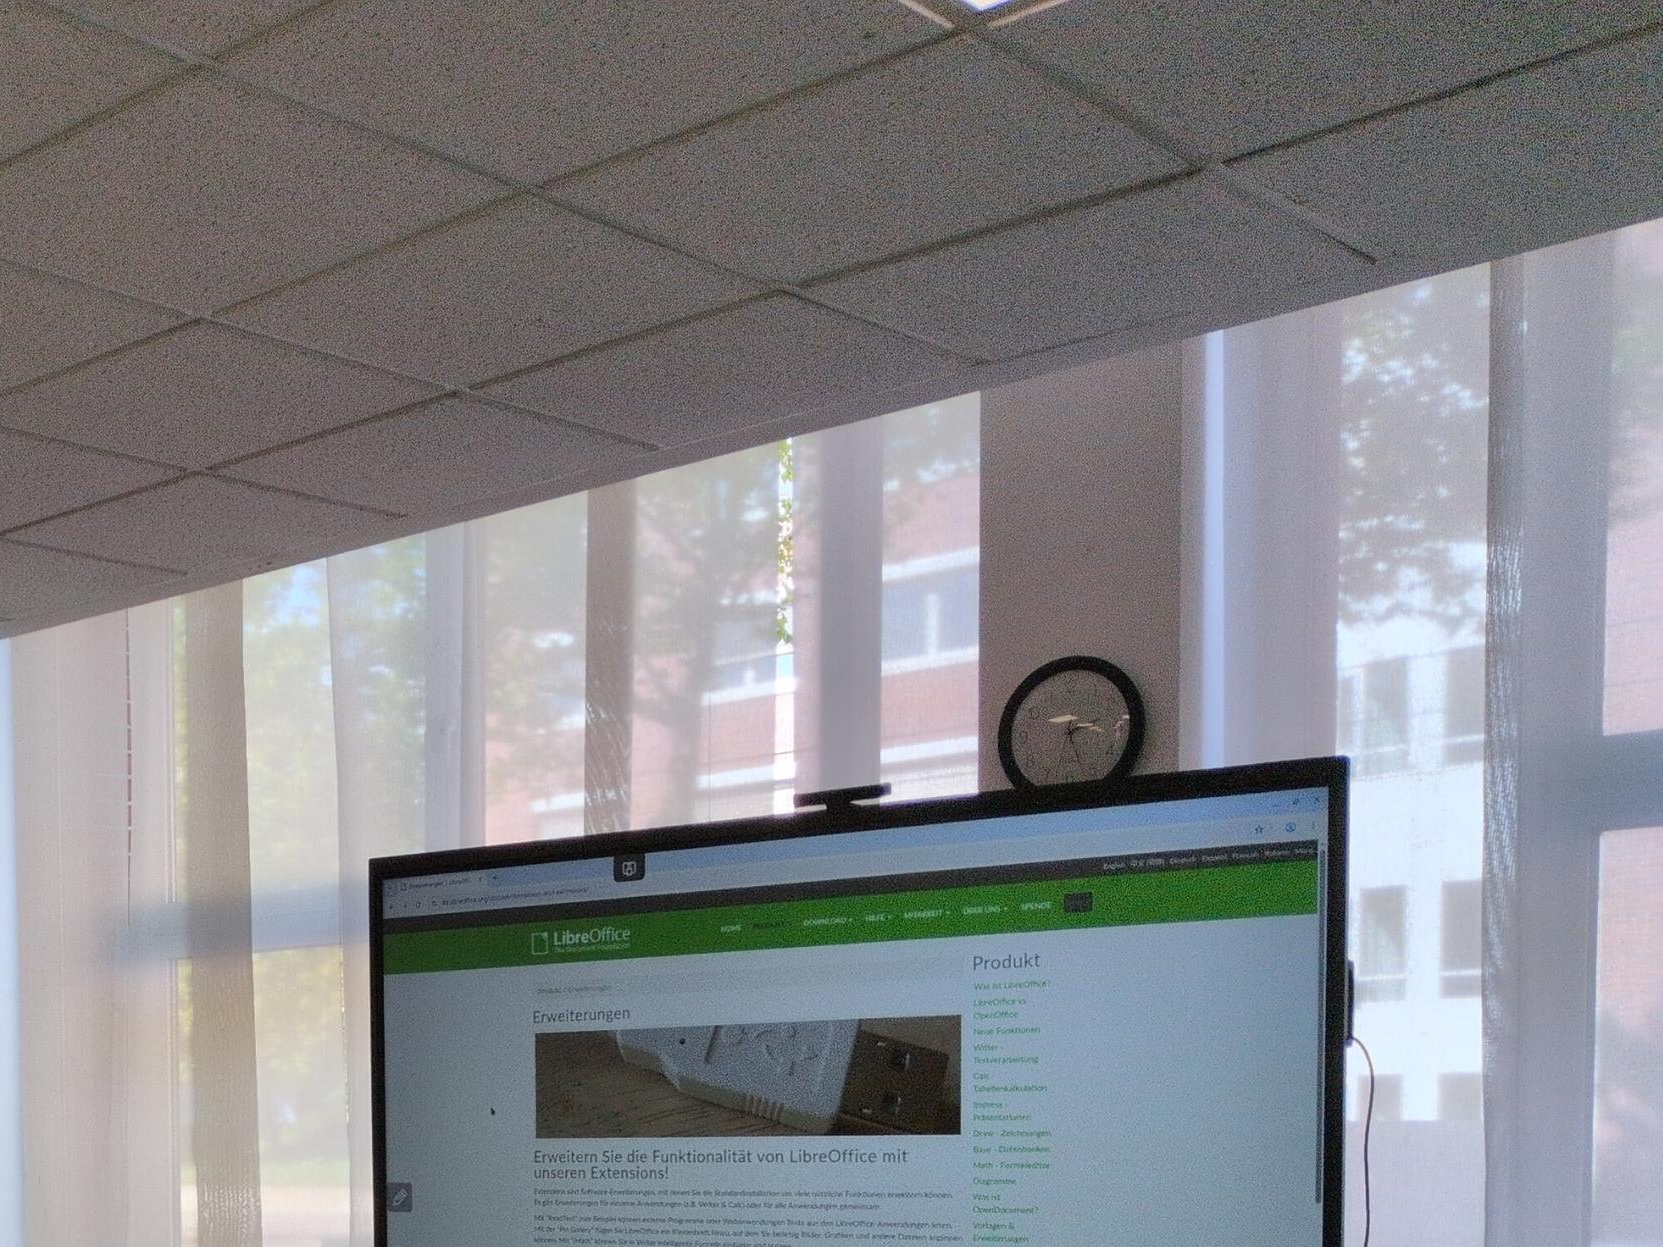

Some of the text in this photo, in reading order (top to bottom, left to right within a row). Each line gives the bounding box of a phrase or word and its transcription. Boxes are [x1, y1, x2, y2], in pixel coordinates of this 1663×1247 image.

[553, 926, 631, 946] LibreOffice
[972, 951, 1040, 970] Produkt
[533, 1008, 631, 1024] Erweiterungen
[533, 1148, 909, 1164] Erweitern Sie die Funktionalität von LibreOffice mit
[534, 1166, 669, 1180] unseren Extensions!
